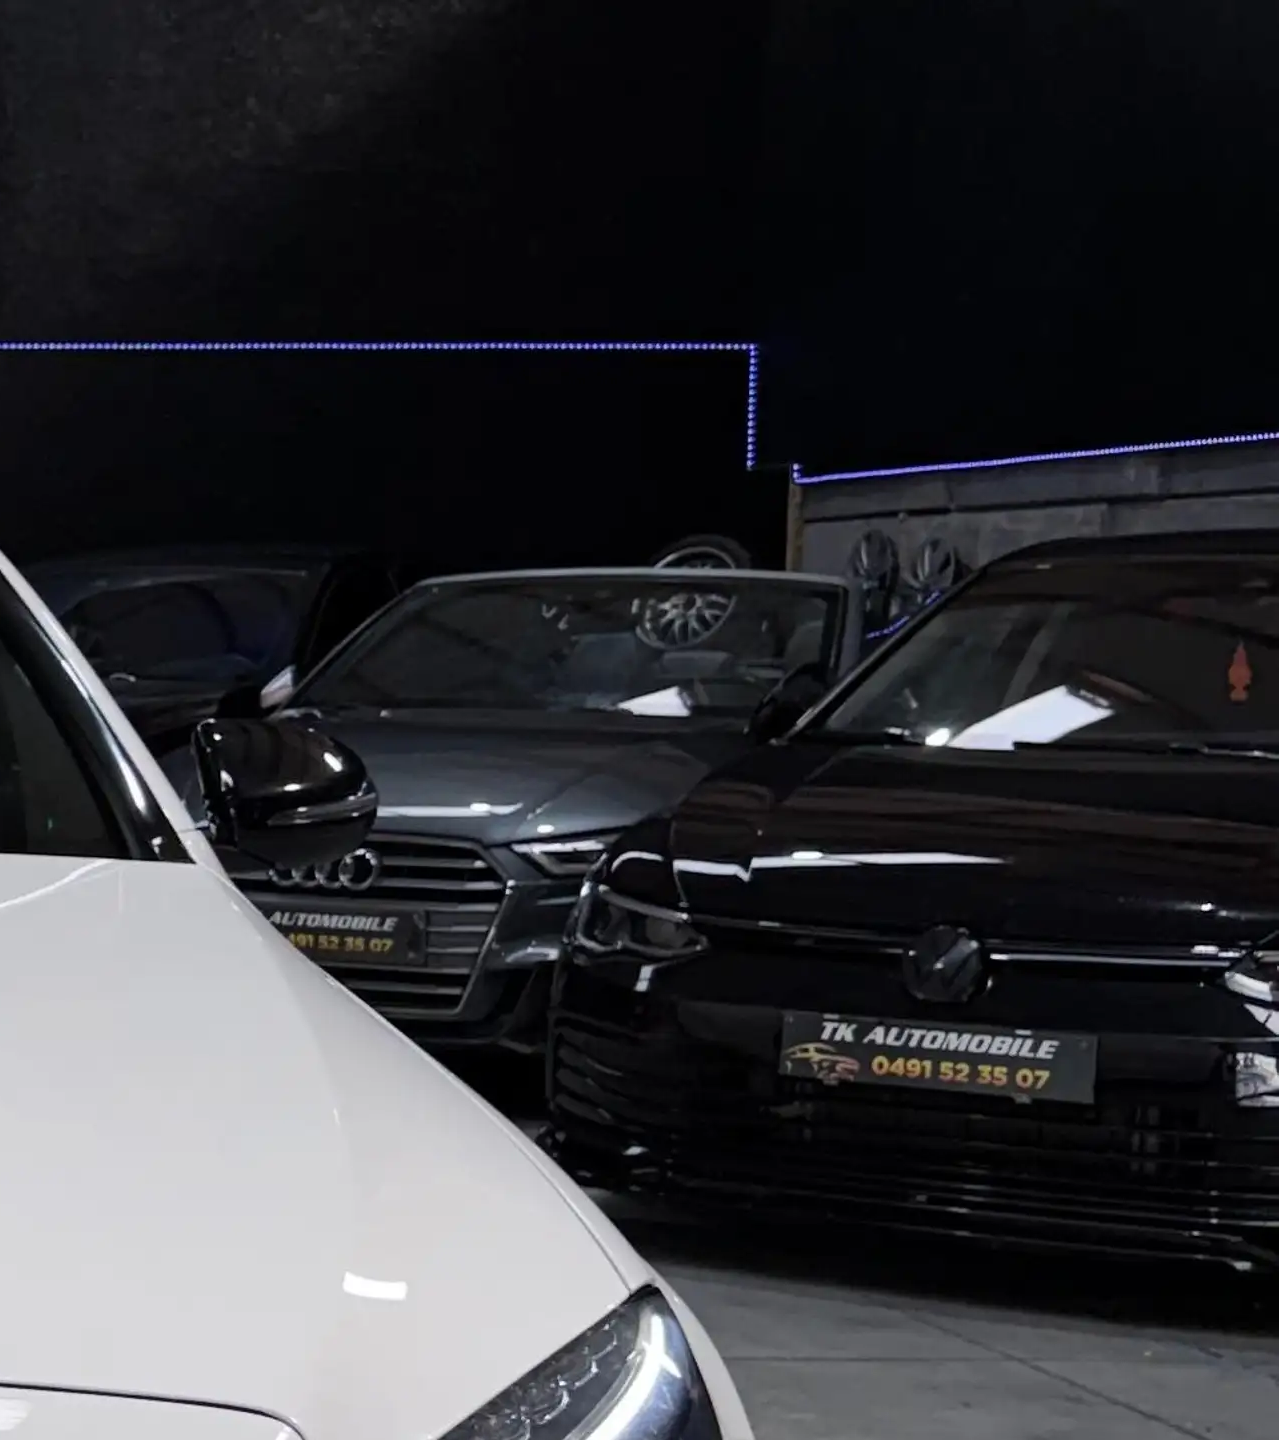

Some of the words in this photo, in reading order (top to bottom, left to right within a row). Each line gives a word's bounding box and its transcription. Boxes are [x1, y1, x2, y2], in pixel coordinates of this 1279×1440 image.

[270, 911, 398, 931] AUTOMOBILE
[820, 1020, 858, 1042] TK
[863, 1025, 1060, 1059] AUTOMOBILE
[871, 1055, 933, 1079] 0491
[939, 1061, 970, 1083] 52
[976, 1064, 1008, 1087] 35
[1015, 1067, 1051, 1090] 07
